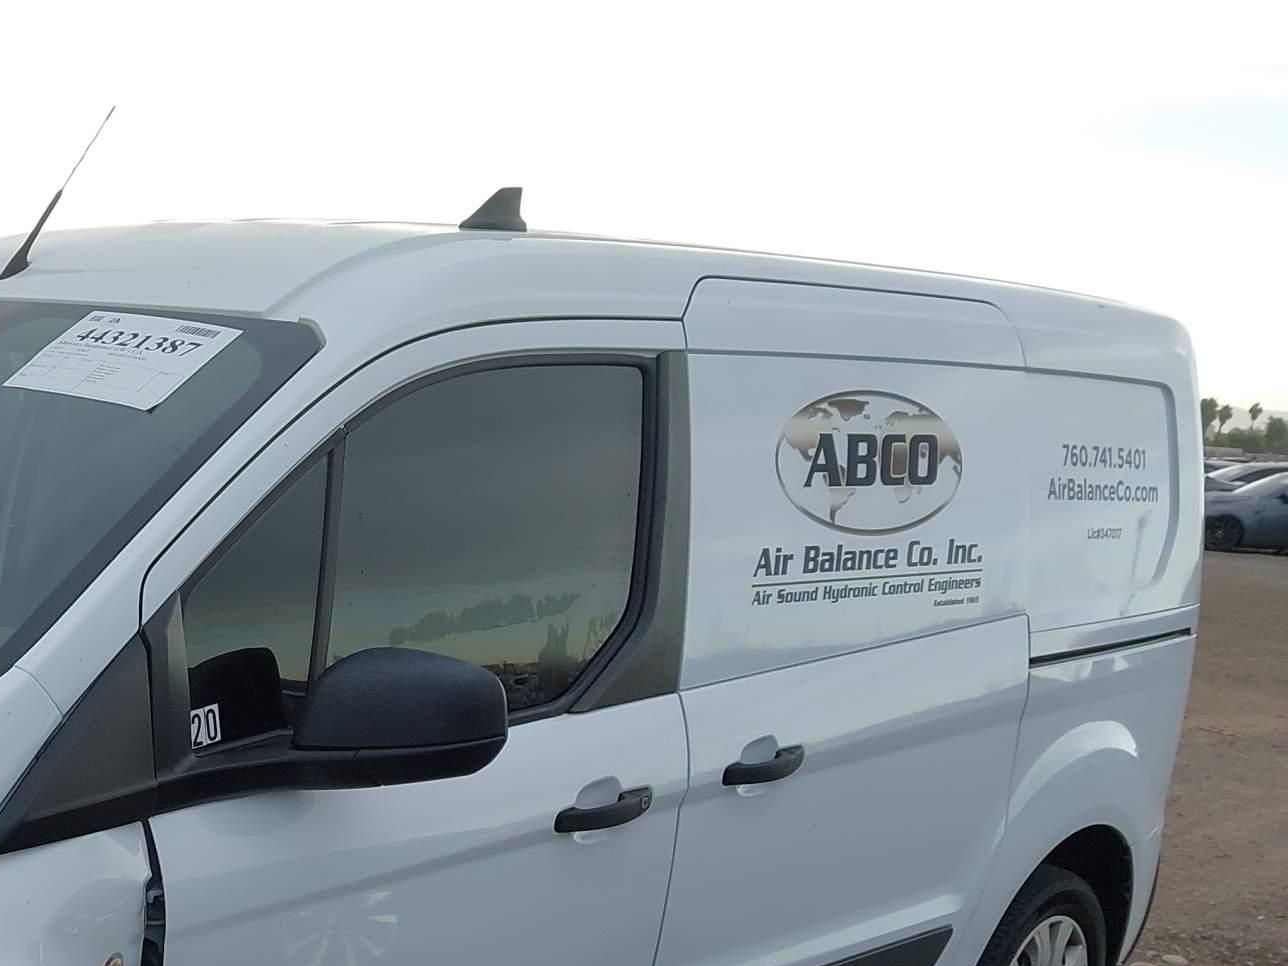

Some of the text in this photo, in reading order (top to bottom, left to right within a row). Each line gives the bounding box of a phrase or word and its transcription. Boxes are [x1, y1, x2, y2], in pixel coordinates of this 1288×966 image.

[76, 327, 204, 357] 44321387
[803, 433, 939, 487] ABCO
[1062, 444, 1146, 470] 760.741.5401
[1047, 477, 1159, 502] AirBalanceCo.com
[753, 538, 983, 577] Air Balance Co. Inc.
[751, 576, 982, 606] Air Sound Hydronic Control Engineers
[192, 708, 218, 747] 20
